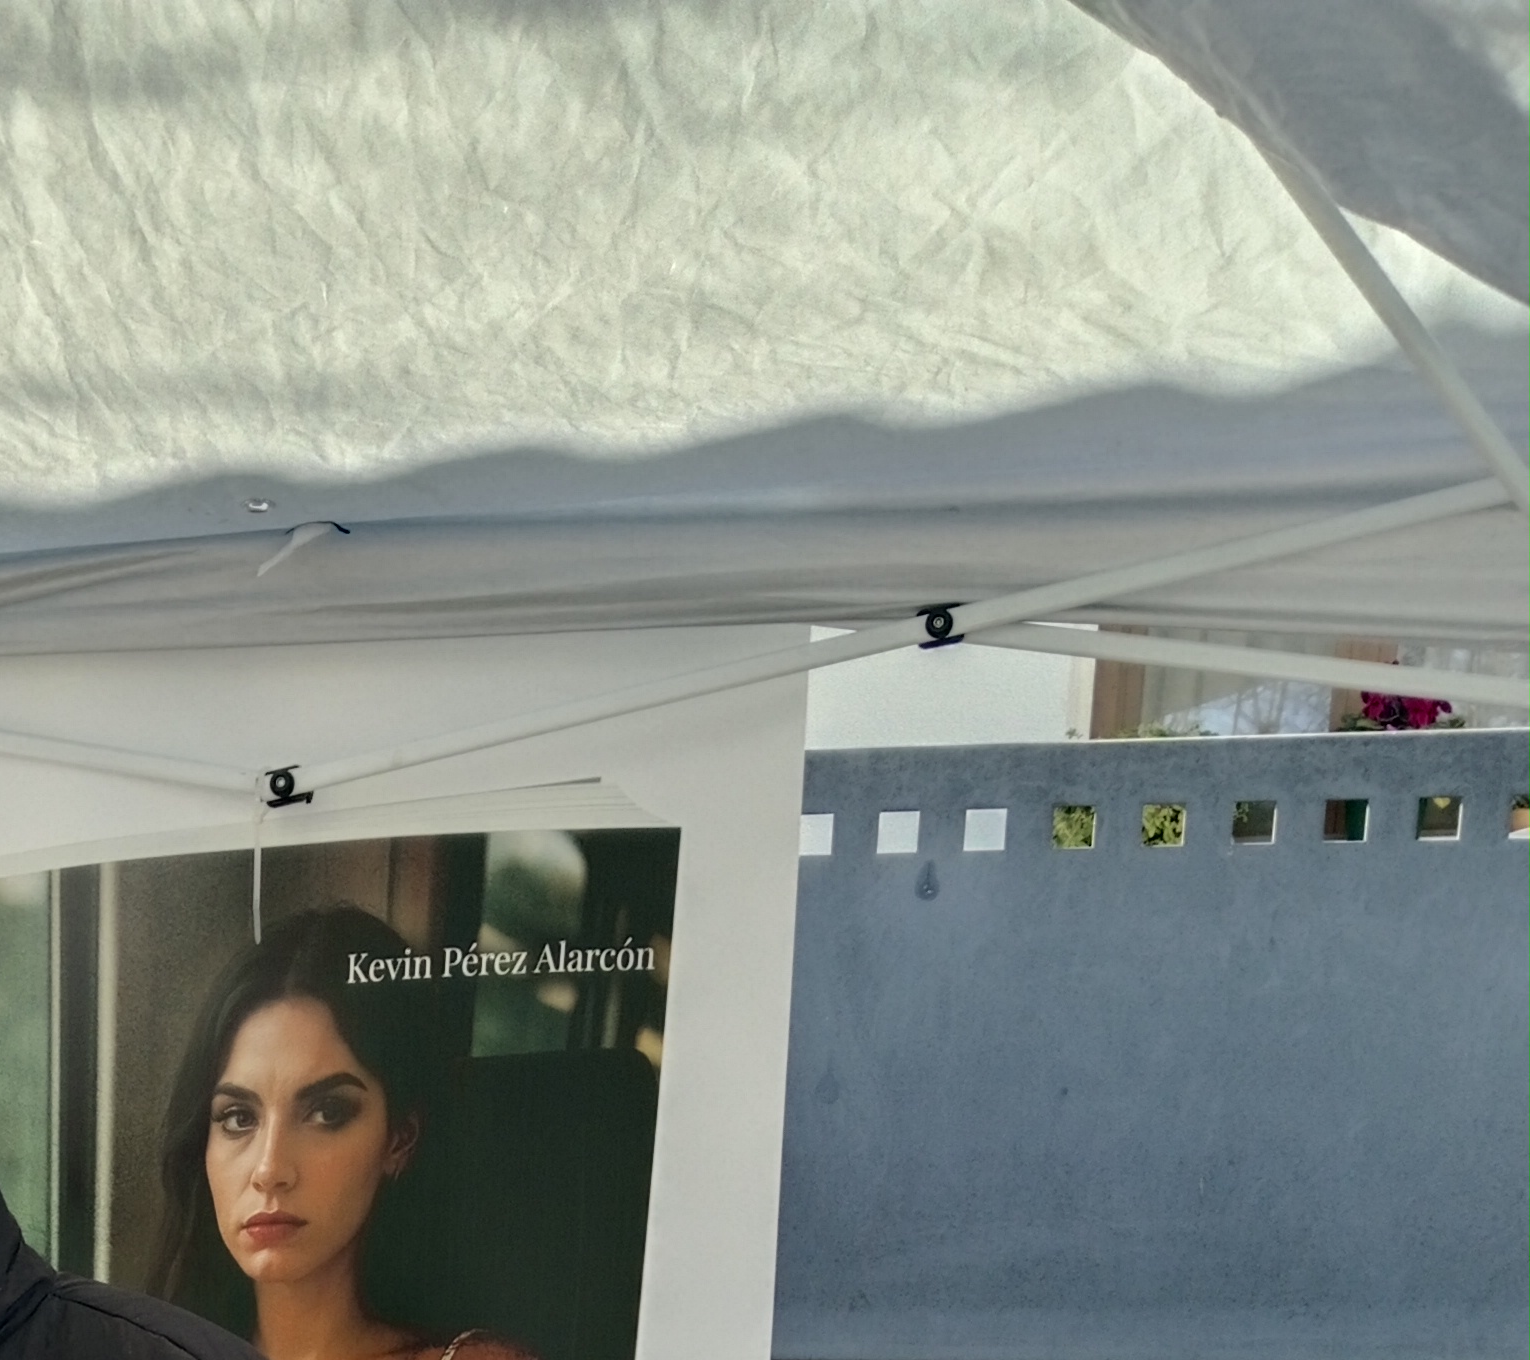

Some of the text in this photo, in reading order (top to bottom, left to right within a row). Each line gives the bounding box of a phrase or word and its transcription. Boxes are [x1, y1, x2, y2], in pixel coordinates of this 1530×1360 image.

[346, 937, 656, 984] Kevin Pérez Alarcón
